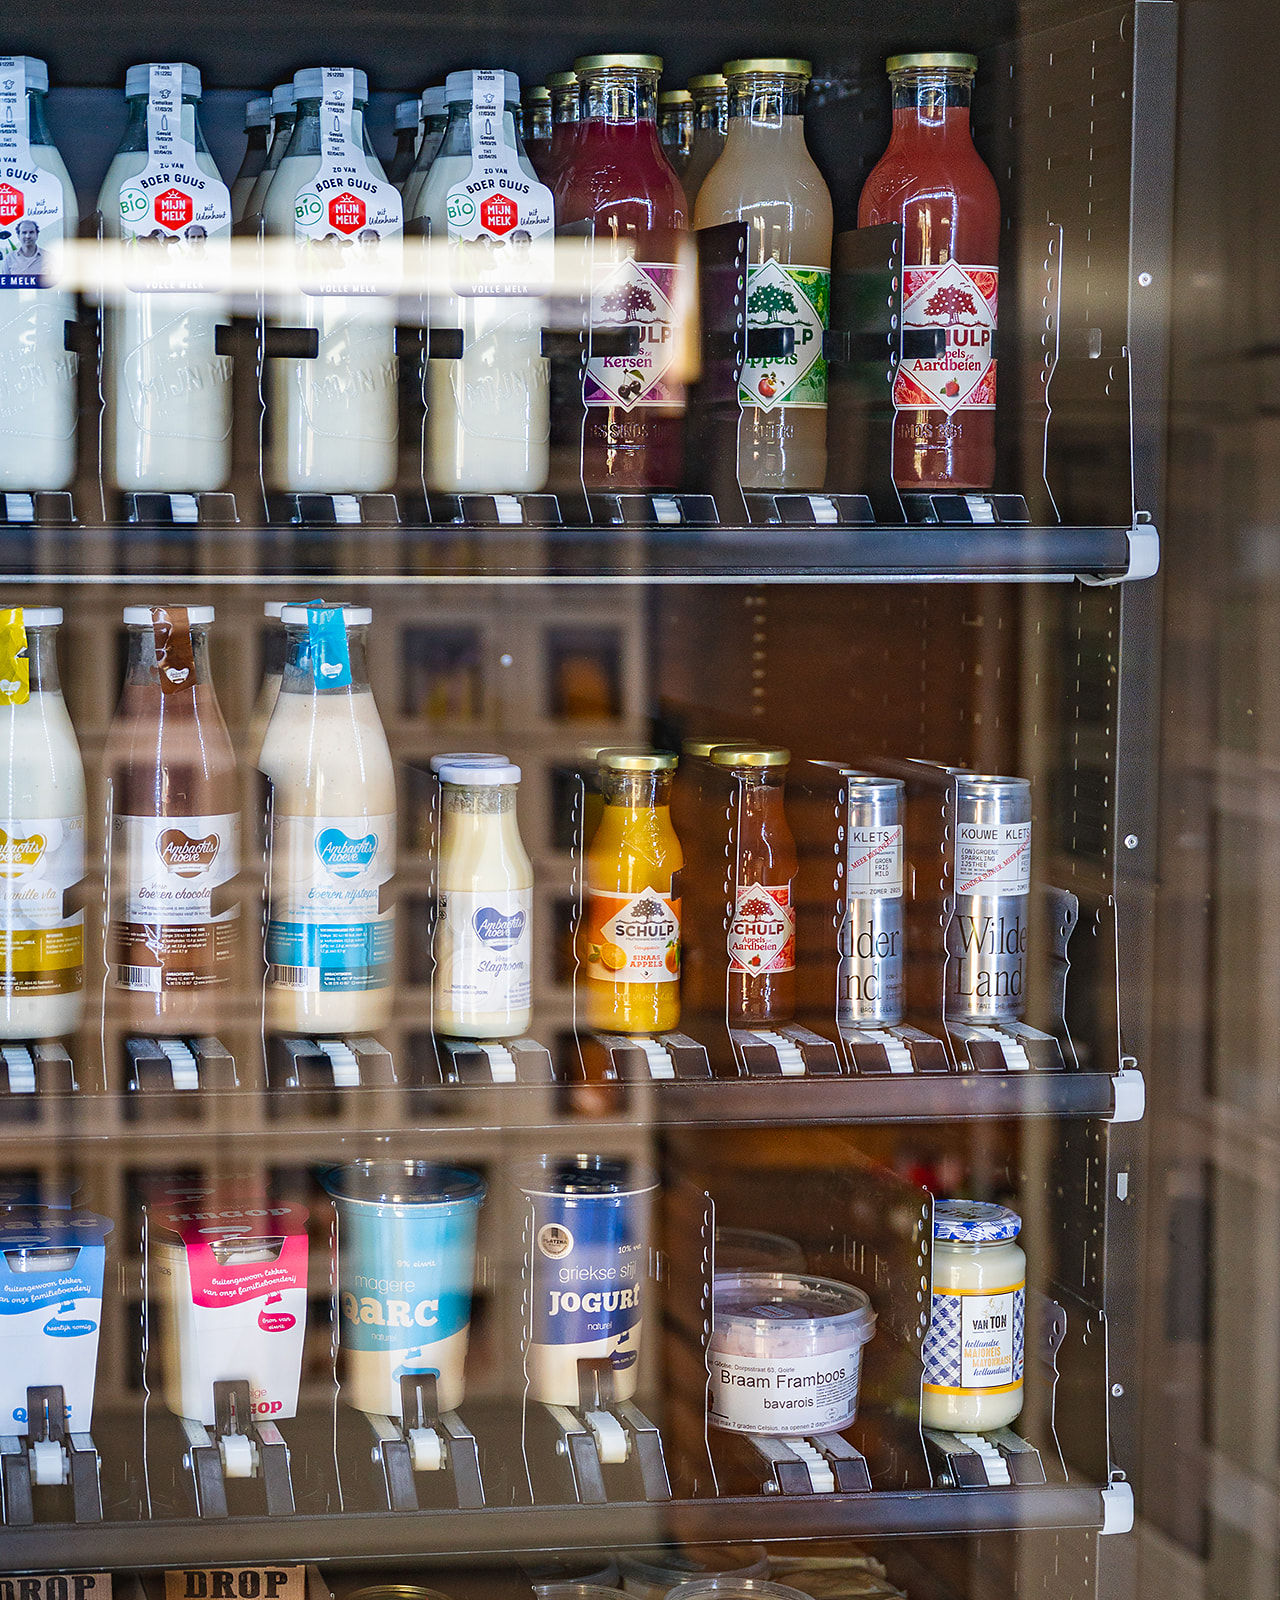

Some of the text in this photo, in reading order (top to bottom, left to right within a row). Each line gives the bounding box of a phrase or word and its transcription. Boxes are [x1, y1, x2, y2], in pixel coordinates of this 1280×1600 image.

[6, 168, 38, 184] GUUS
[140, 174, 206, 190] BOER GUUS
[316, 178, 378, 194] BOER GUUS
[466, 179, 530, 194] BOER GUUS
[0, 195, 17, 204] IJN
[162, 200, 186, 210] MIJN
[0, 206, 17, 216] ELK
[28, 206, 59, 216] Udenhout
[336, 204, 359, 213] MIJN
[488, 206, 510, 214] MIJN
[162, 211, 186, 221] MELK
[196, 212, 227, 221] Udenhout
[336, 216, 359, 225] MELK
[368, 216, 398, 226] Udenhout
[488, 217, 511, 226] MELK
[520, 216, 550, 226] Udenhout
[472, 285, 528, 293] VOLLE MELK
[945, 349, 965, 359] pels
[603, 356, 652, 368] Kersen
[746, 354, 798, 368] ppels
[913, 358, 981, 371] Aardbeien
[854, 832, 889, 842] KLETS
[961, 828, 1030, 840] KOUWE KLETS
[163, 841, 217, 857] Ambachts
[321, 841, 376, 857] Ambachts
[170, 852, 200, 862] hoeve
[328, 852, 358, 862] hoeve
[960, 876, 983, 892] MINDER
[616, 925, 674, 937] SCHULP
[840, 920, 900, 958] ilder
[732, 942, 777, 951] Aardbeien
[477, 960, 524, 978] Slagroom
[954, 957, 1022, 997] Land
[618, 1245, 632, 1254] 10%
[212, 1268, 288, 1286] buitengewoon lekker
[559, 1266, 617, 1283] griekse
[4, 1277, 82, 1292] buitengewoon lekker
[238, 1276, 296, 1295] familieboerderij
[355, 1276, 416, 1294] magere
[31, 1285, 91, 1302] familieboerderij
[46, 1322, 71, 1331] heerlijk
[588, 1322, 612, 1330] naturel
[972, 1314, 1007, 1330] VAN TON
[964, 1339, 1000, 1348] hollandse
[972, 1355, 1012, 1367] MAYONNAISE
[734, 1364, 766, 1373] Dorpsstraat
[973, 1366, 1011, 1376] hollandaise
[721, 1368, 846, 1389] Braam Framboos
[764, 1398, 814, 1409] bavarois
[184, 1570, 288, 1598] DROP
